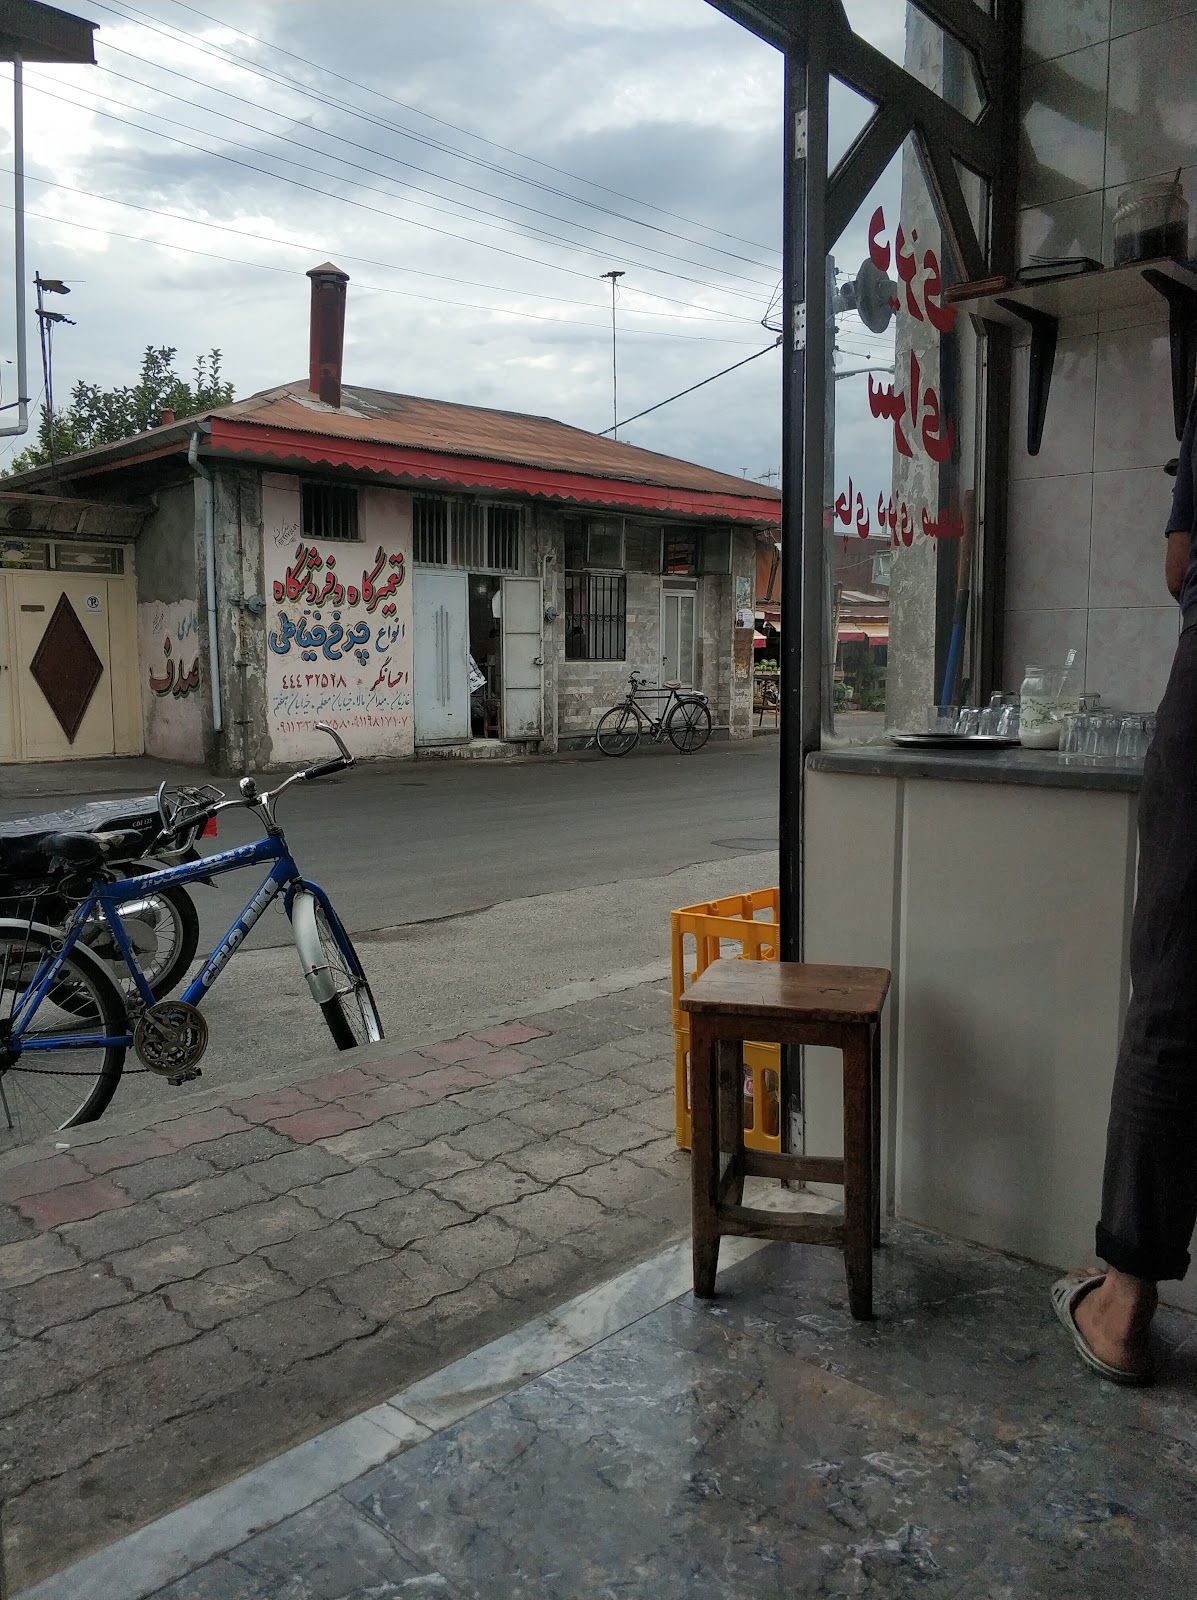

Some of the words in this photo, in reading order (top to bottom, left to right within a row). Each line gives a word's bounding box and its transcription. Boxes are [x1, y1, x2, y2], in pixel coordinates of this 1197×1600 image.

[273, 542, 336, 608] فروشگاه
[347, 545, 406, 619] تعمیرگاه
[323, 610, 371, 667] چرخ
[374, 617, 406, 653] انواع
